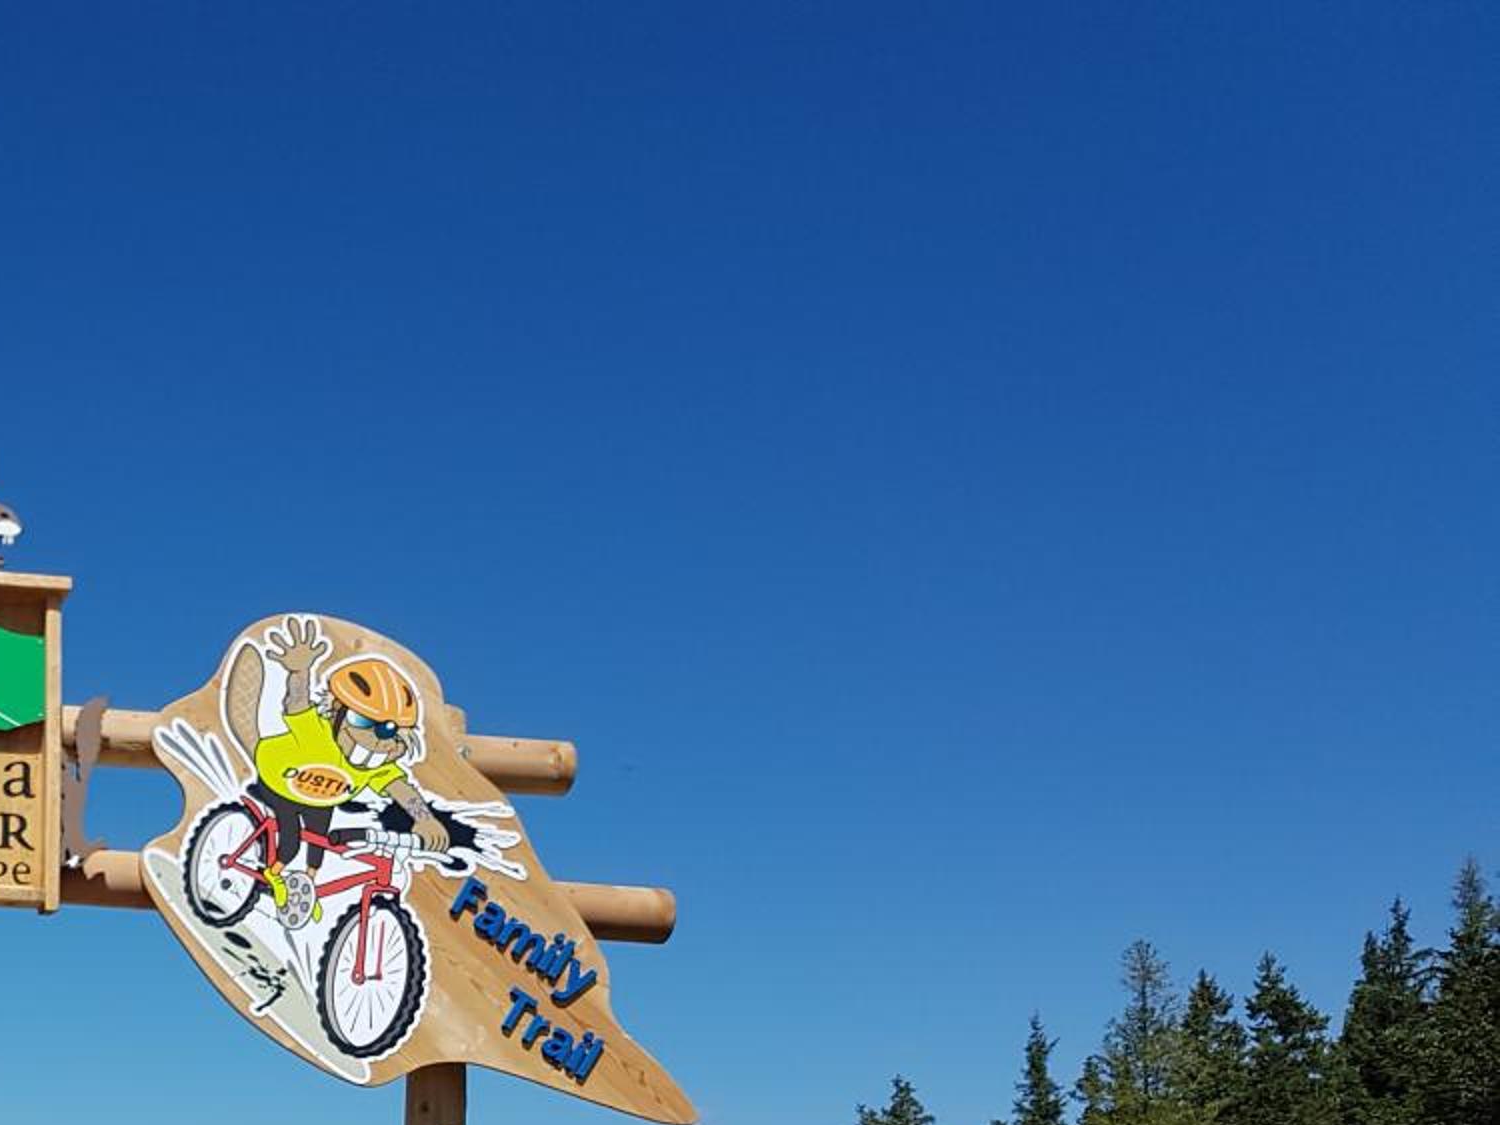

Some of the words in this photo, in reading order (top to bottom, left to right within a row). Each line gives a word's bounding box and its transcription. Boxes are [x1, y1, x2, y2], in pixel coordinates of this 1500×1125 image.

[282, 767, 359, 795] DUSTIN
[450, 876, 597, 1007] Family
[500, 987, 604, 1086] Trail
